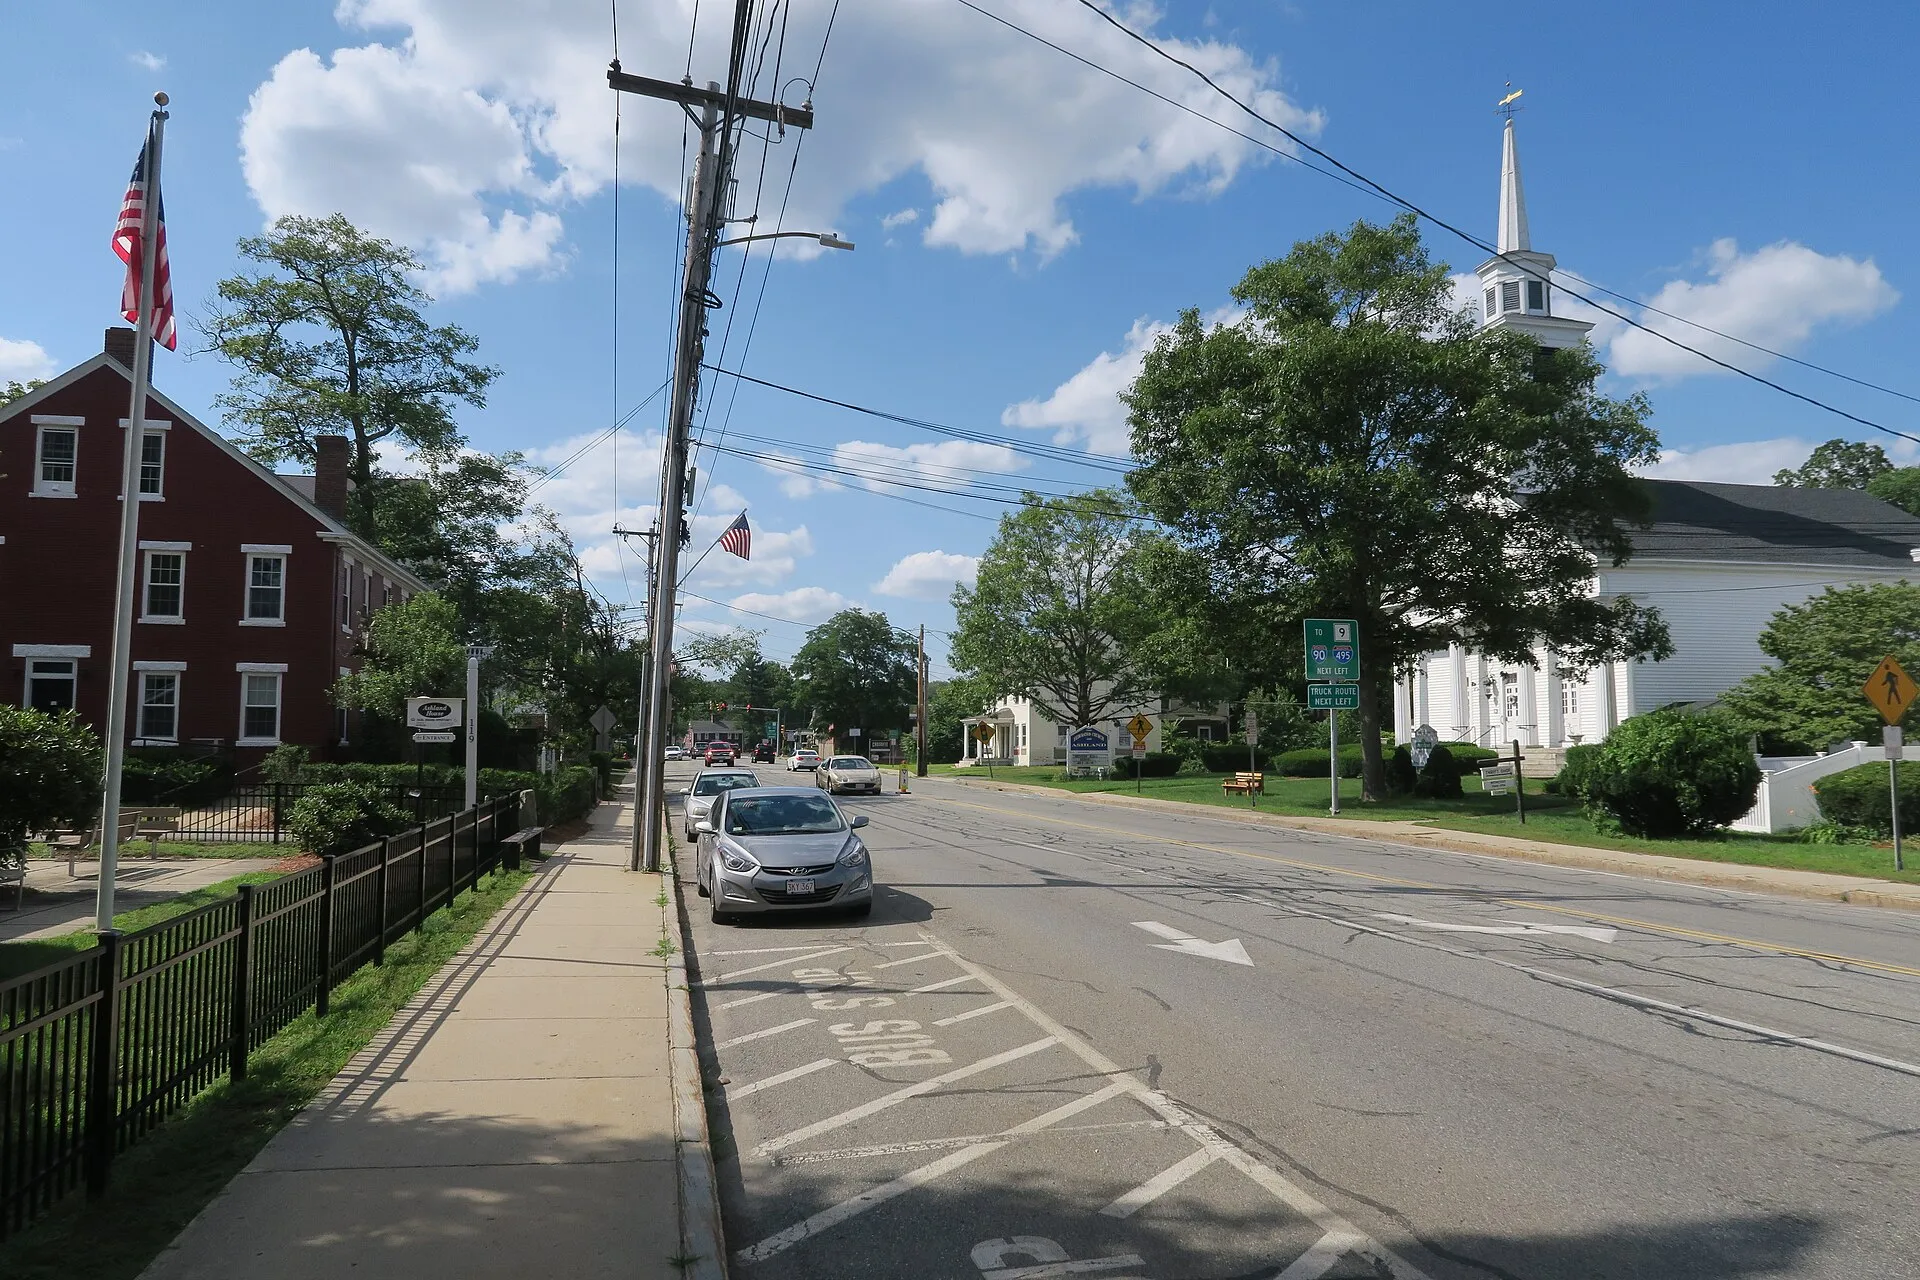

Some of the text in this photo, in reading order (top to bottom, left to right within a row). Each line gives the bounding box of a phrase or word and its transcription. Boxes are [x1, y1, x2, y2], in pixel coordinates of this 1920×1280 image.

[1315, 628, 1323, 636] TO
[1339, 627, 1345, 637] 9
[1313, 650, 1325, 660] 90
[1336, 651, 1350, 660] 495
[1317, 667, 1348, 675] NEXT LEFT
[1311, 687, 1356, 695] TRUCK ROUTE
[1315, 697, 1352, 706] NEXT LEFT
[801, 882, 813, 891] 367
[827, 1019, 953, 1068] BUS
